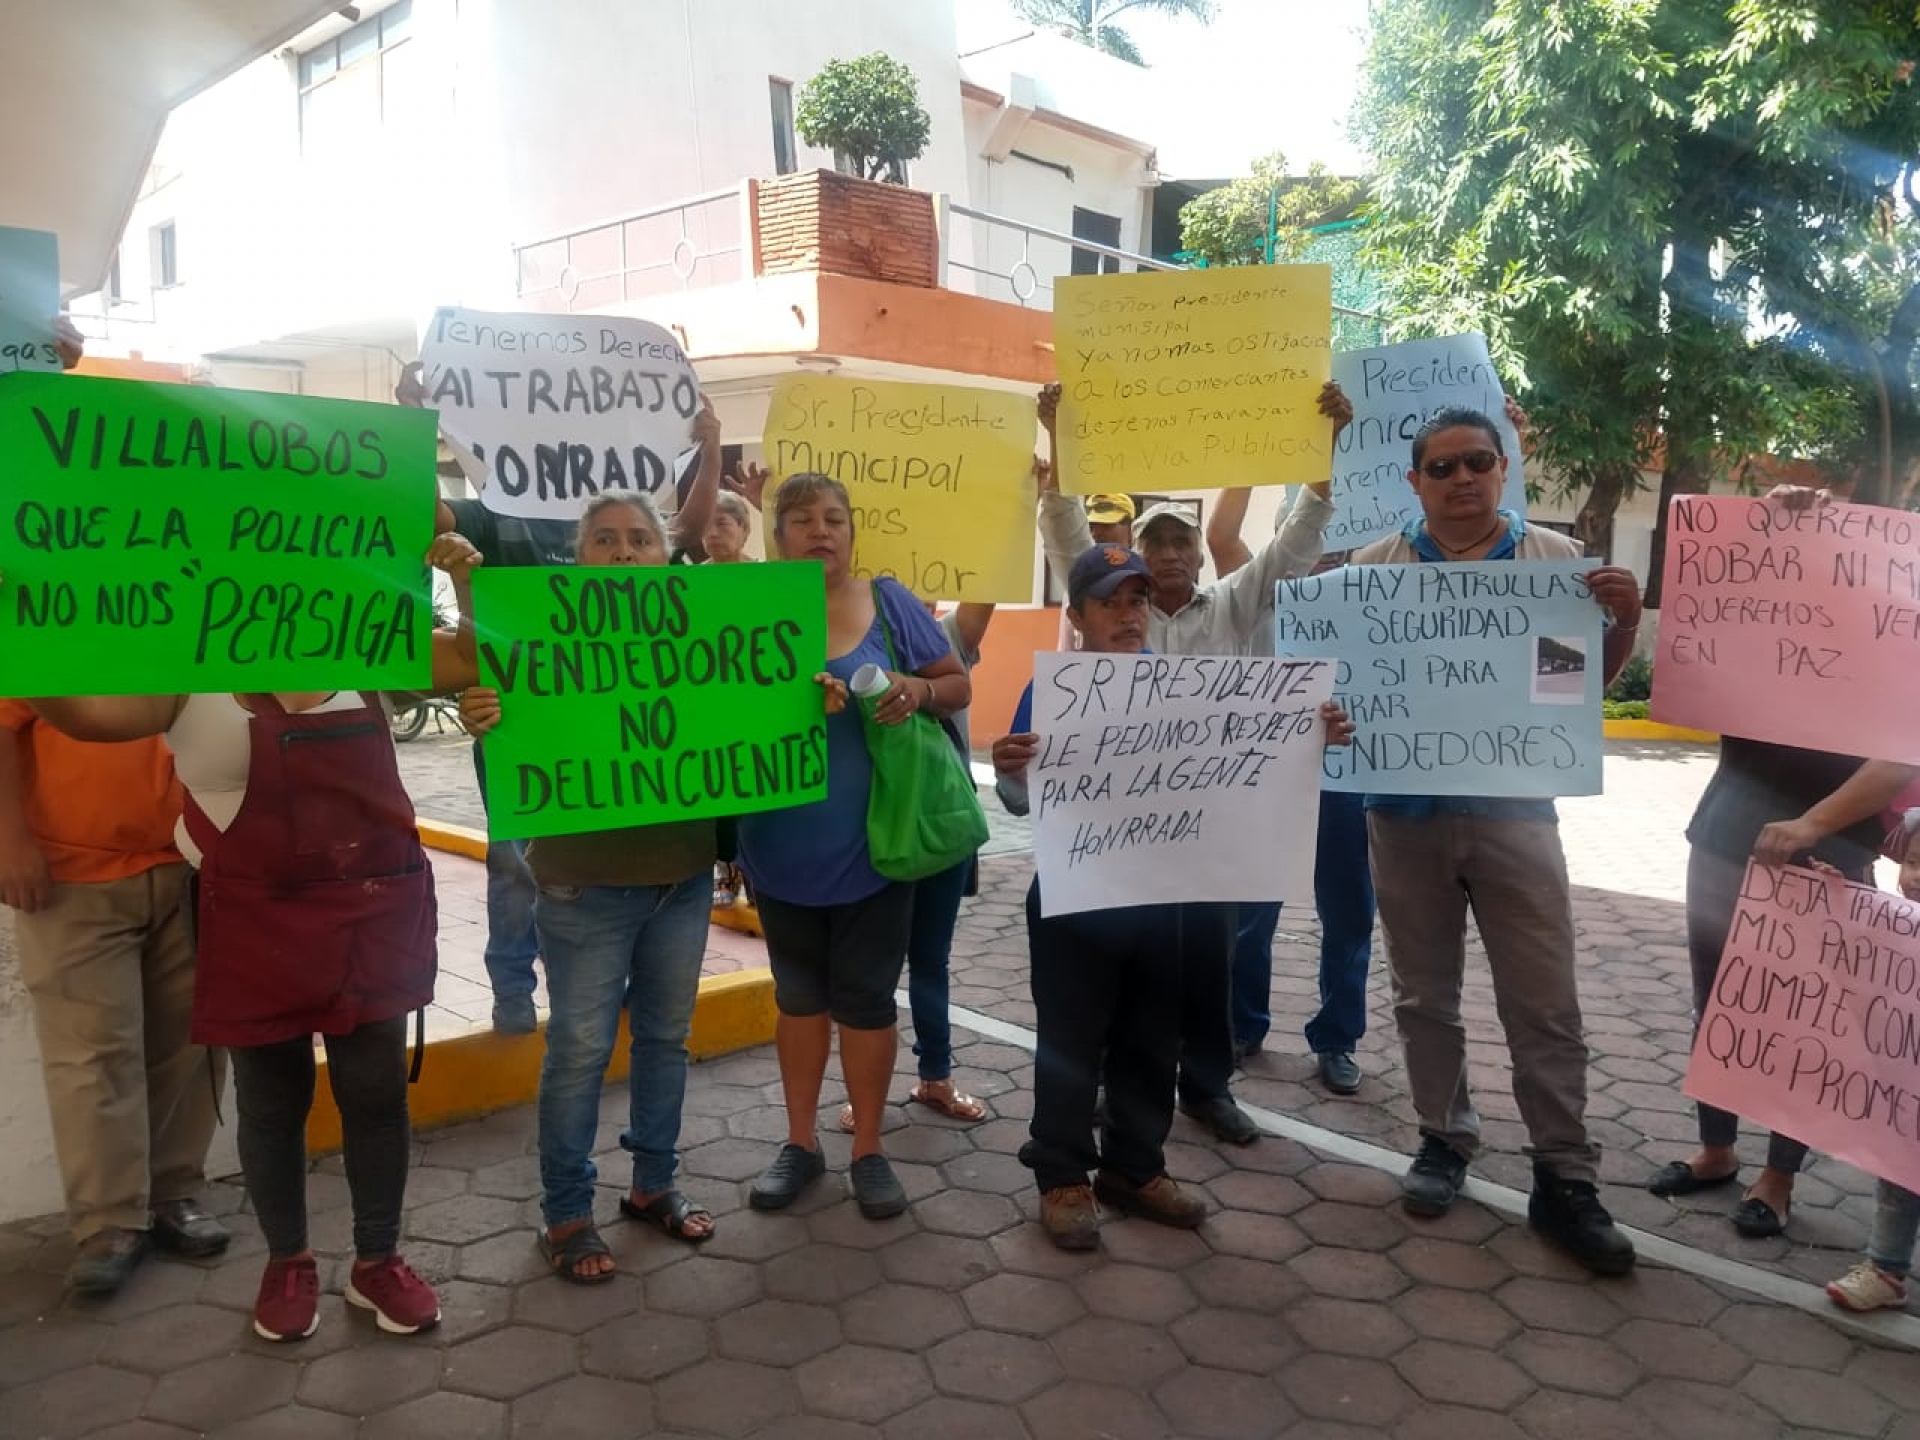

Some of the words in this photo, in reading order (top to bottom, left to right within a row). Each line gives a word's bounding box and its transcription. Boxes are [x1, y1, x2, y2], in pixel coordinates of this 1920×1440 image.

[436, 308, 588, 353] Tenemos
[483, 365, 697, 419] TRABAJO
[31, 406, 388, 480] VILLALOBOS
[473, 441, 667, 502] ONRAD
[15, 501, 110, 553] QUE
[124, 507, 192, 551] LA
[228, 505, 397, 559] POLICIA
[1675, 499, 1717, 534] NO
[1746, 501, 1914, 547] QUEREMO
[1278, 575, 1322, 605] NO
[1343, 566, 1406, 603] HAY
[1419, 566, 1593, 603] PATRULLAS
[1677, 539, 1804, 587] ROBAR
[1832, 551, 1867, 588] NI
[17, 580, 77, 628] NO
[96, 580, 175, 629] NOS
[549, 574, 689, 639] SOMOS
[1280, 610, 1340, 642] PARA
[1362, 605, 1531, 645] SEGURIDAD
[1673, 593, 1835, 631] QUEREMOS
[480, 619, 802, 697] VENDEDORES
[1373, 658, 1405, 687] SI
[1425, 655, 1499, 688] PARA
[1671, 635, 1717, 666] EN
[1776, 637, 1843, 679] PAZ
[1126, 657, 1329, 715] PRESIDENTE
[618, 696, 678, 752] NO
[1037, 733, 1081, 772] LE
[1094, 713, 1222, 765] PEDIMOS
[1220, 706, 1316, 748] RESPETO
[1322, 724, 1586, 780] ENDEDORES.
[512, 724, 827, 816] DELINCUENTES
[1039, 772, 1112, 819] PARA
[1740, 860, 1831, 917] DEJA
[1731, 908, 1796, 961] MIS
[1818, 918, 1920, 997] PAPITO
[1716, 955, 1857, 1038] CUMPLE
[1706, 1012, 1786, 1077] QUE
